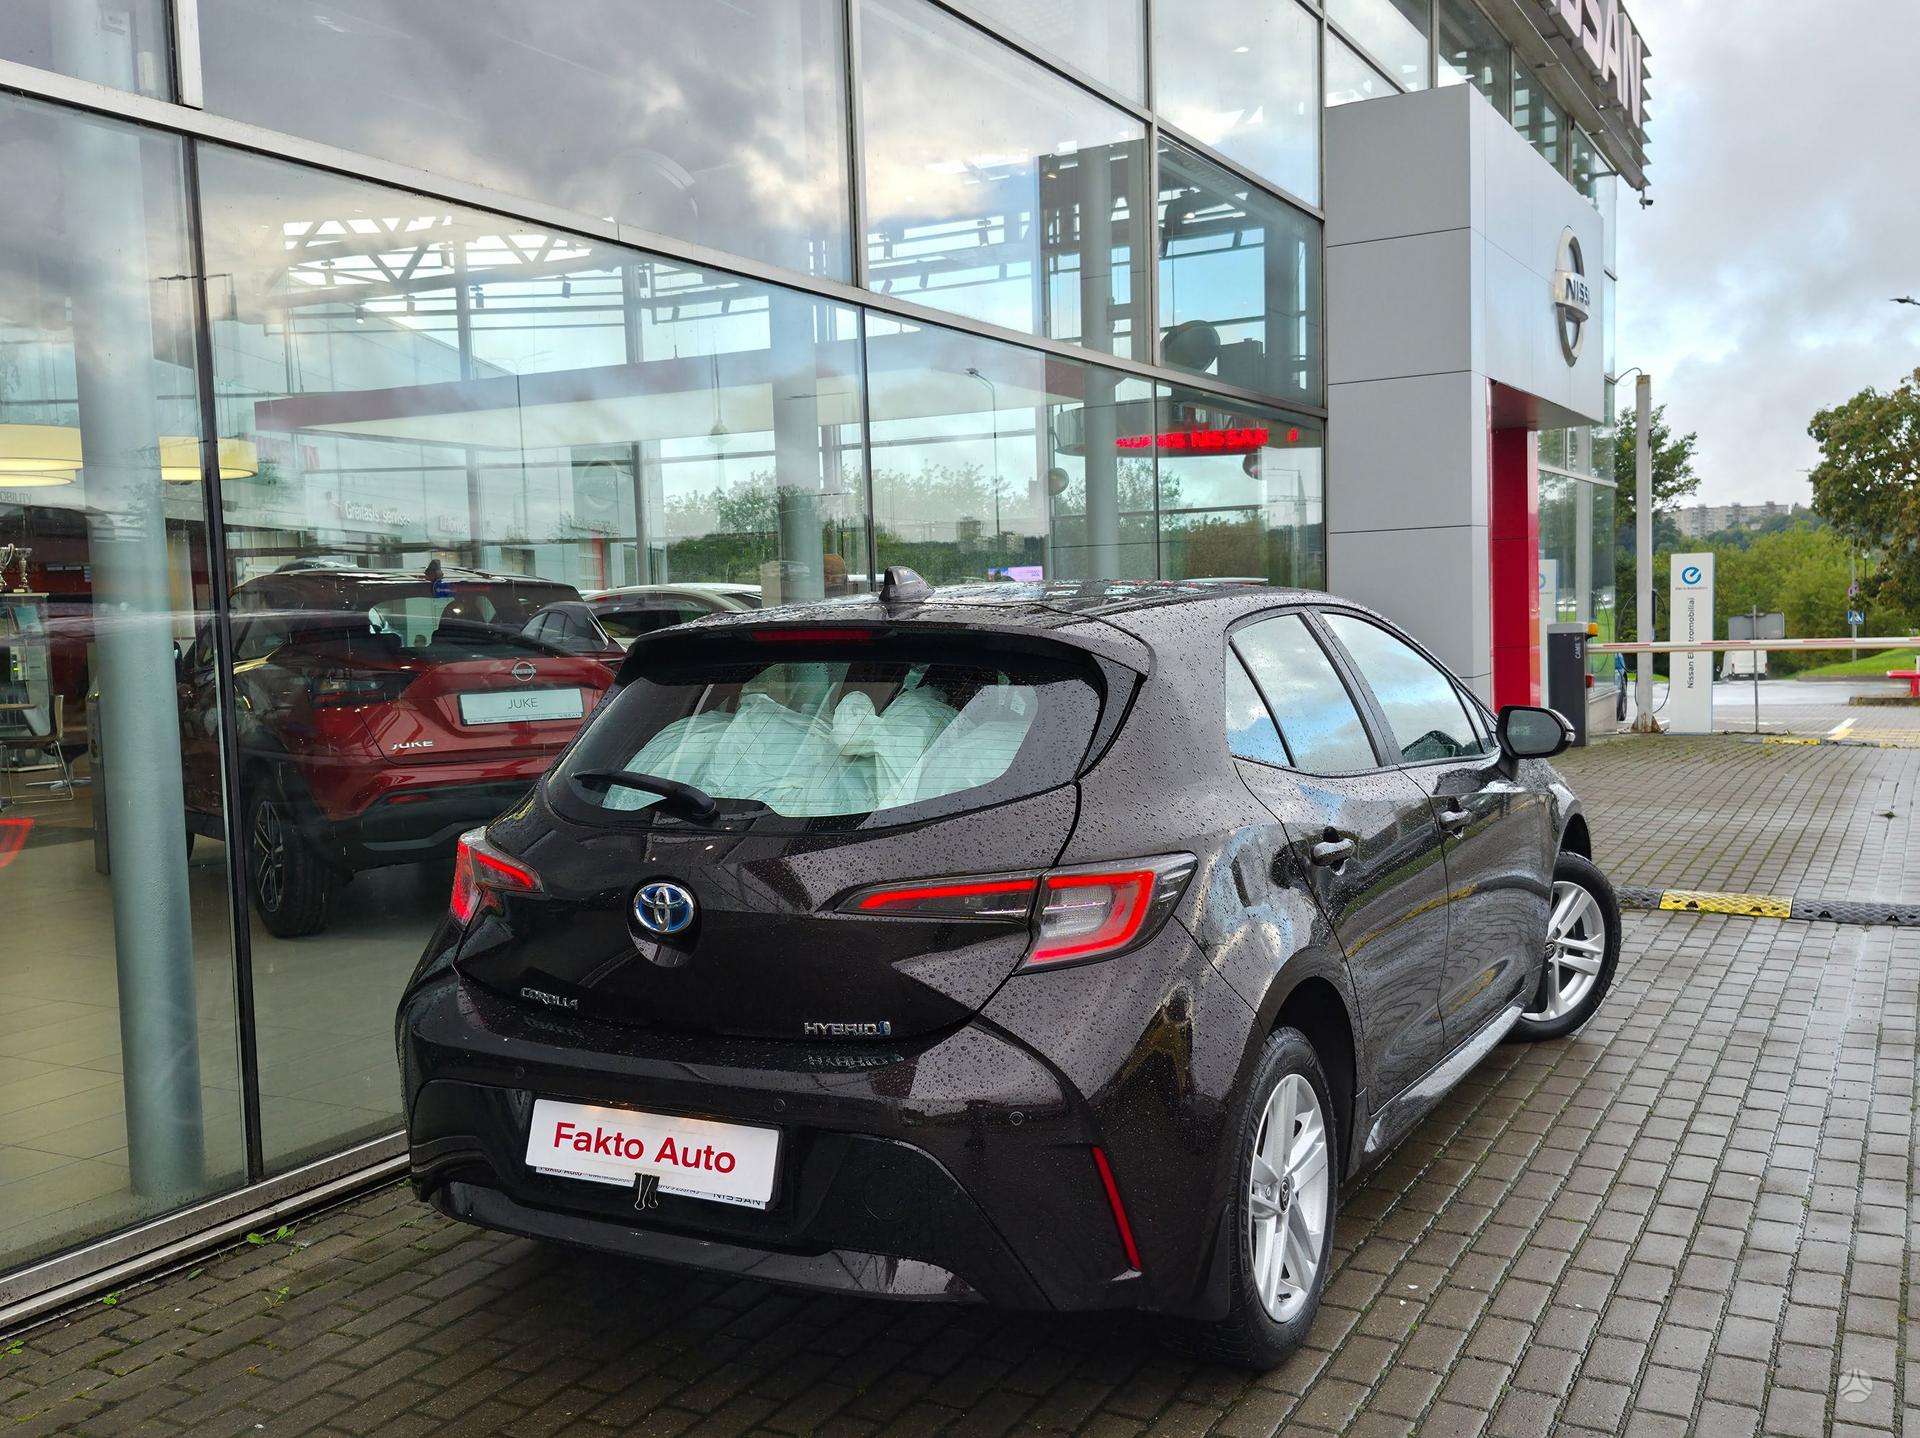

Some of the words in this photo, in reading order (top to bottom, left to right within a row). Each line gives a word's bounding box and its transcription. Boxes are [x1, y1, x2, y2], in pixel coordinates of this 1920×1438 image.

[1687, 661, 1696, 689] Nissan
[507, 697, 538, 710] JUKE
[391, 740, 434, 750] JUKE
[520, 987, 578, 1009] COROLLA
[803, 1022, 878, 1035] HYBRID
[553, 1121, 645, 1160] Fakto
[654, 1137, 736, 1174] Auto
